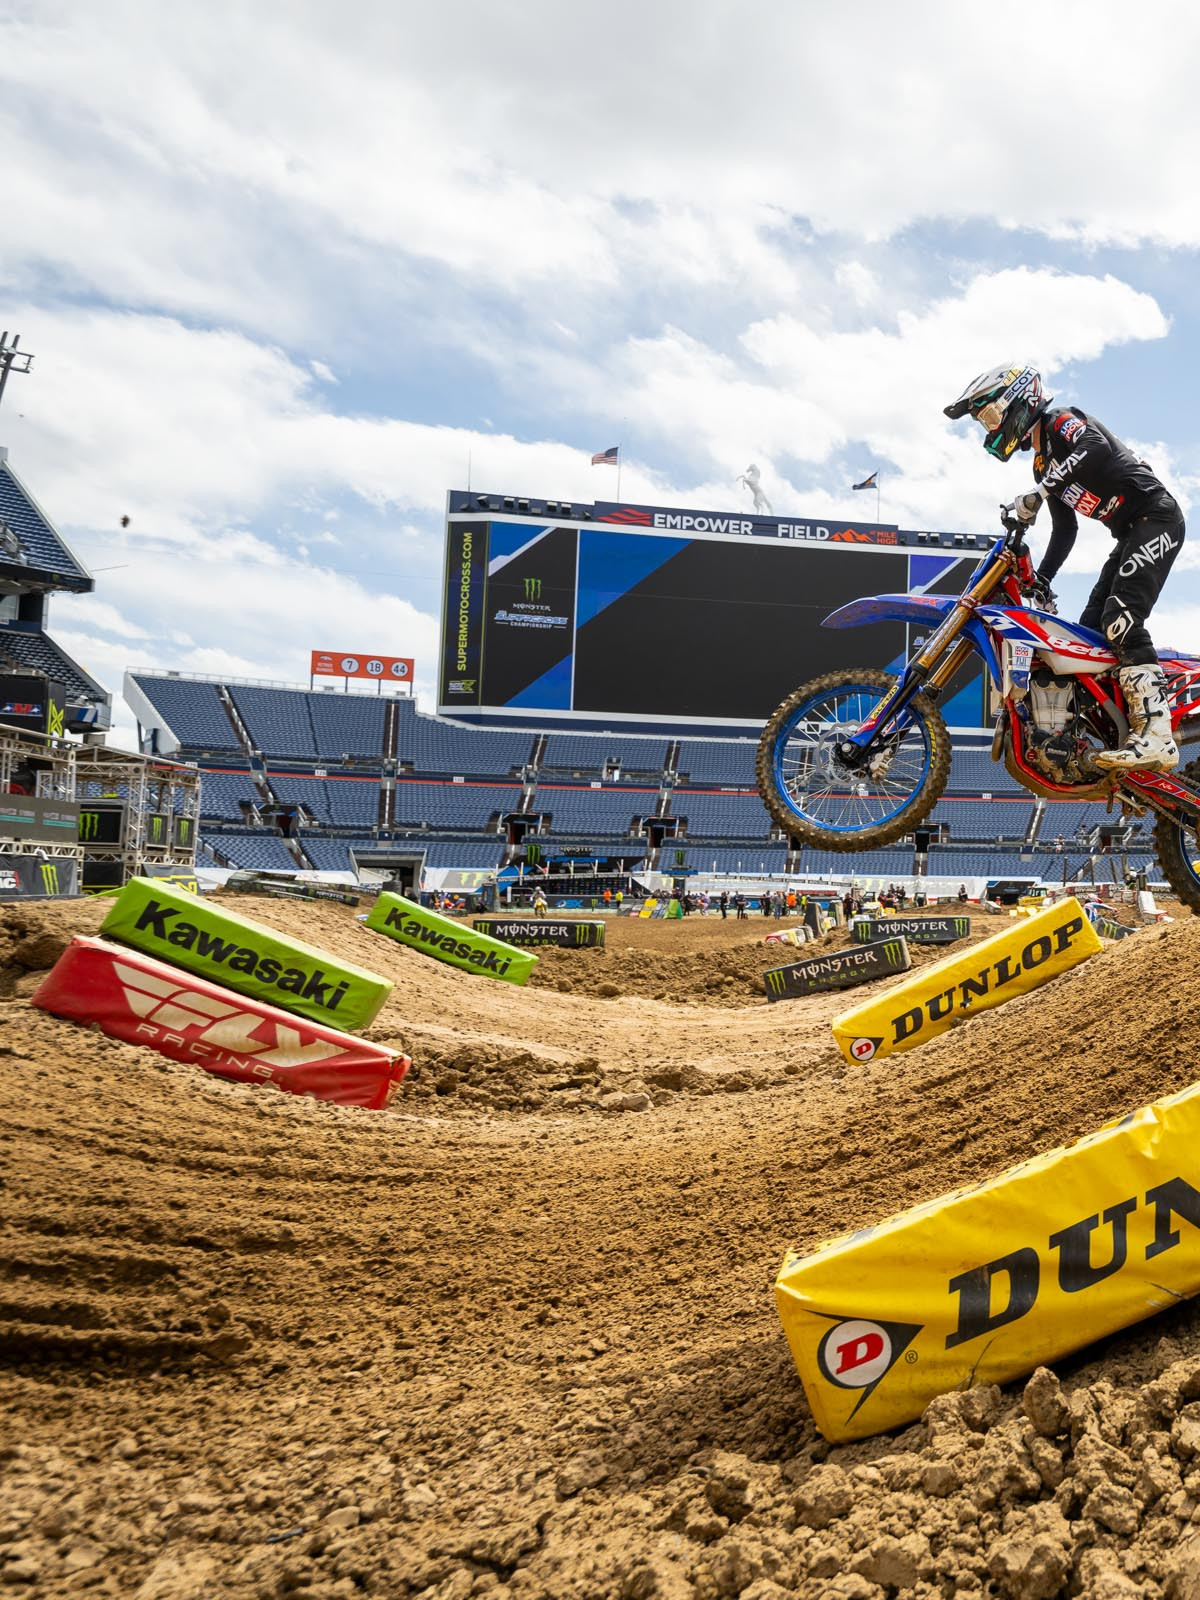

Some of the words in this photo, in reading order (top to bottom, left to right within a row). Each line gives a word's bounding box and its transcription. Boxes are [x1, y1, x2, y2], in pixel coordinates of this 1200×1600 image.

[653, 513, 753, 535] EMPOWER
[777, 523, 830, 541] FIELD
[876, 531, 897, 539] MILE
[457, 532, 473, 671] SUPERMOTOCROSS.COM
[512, 603, 551, 612] MONSTER
[347, 660, 353, 670] 7
[370, 662, 381, 672] 18
[393, 664, 405, 674] 44
[384, 907, 513, 976] Kawasaki
[495, 923, 568, 938] MONSTER
[877, 921, 949, 935] MONSTER
[134, 900, 350, 1011] Kawasaki
[792, 950, 878, 981] MONSTER
[808, 966, 868, 987] ENERGY
[891, 917, 1084, 1045] DUNLOP
[112, 960, 351, 1068] FLY
[136, 1023, 275, 1079] RACING
[855, 1041, 872, 1057] D
[835, 1332, 885, 1375] D
